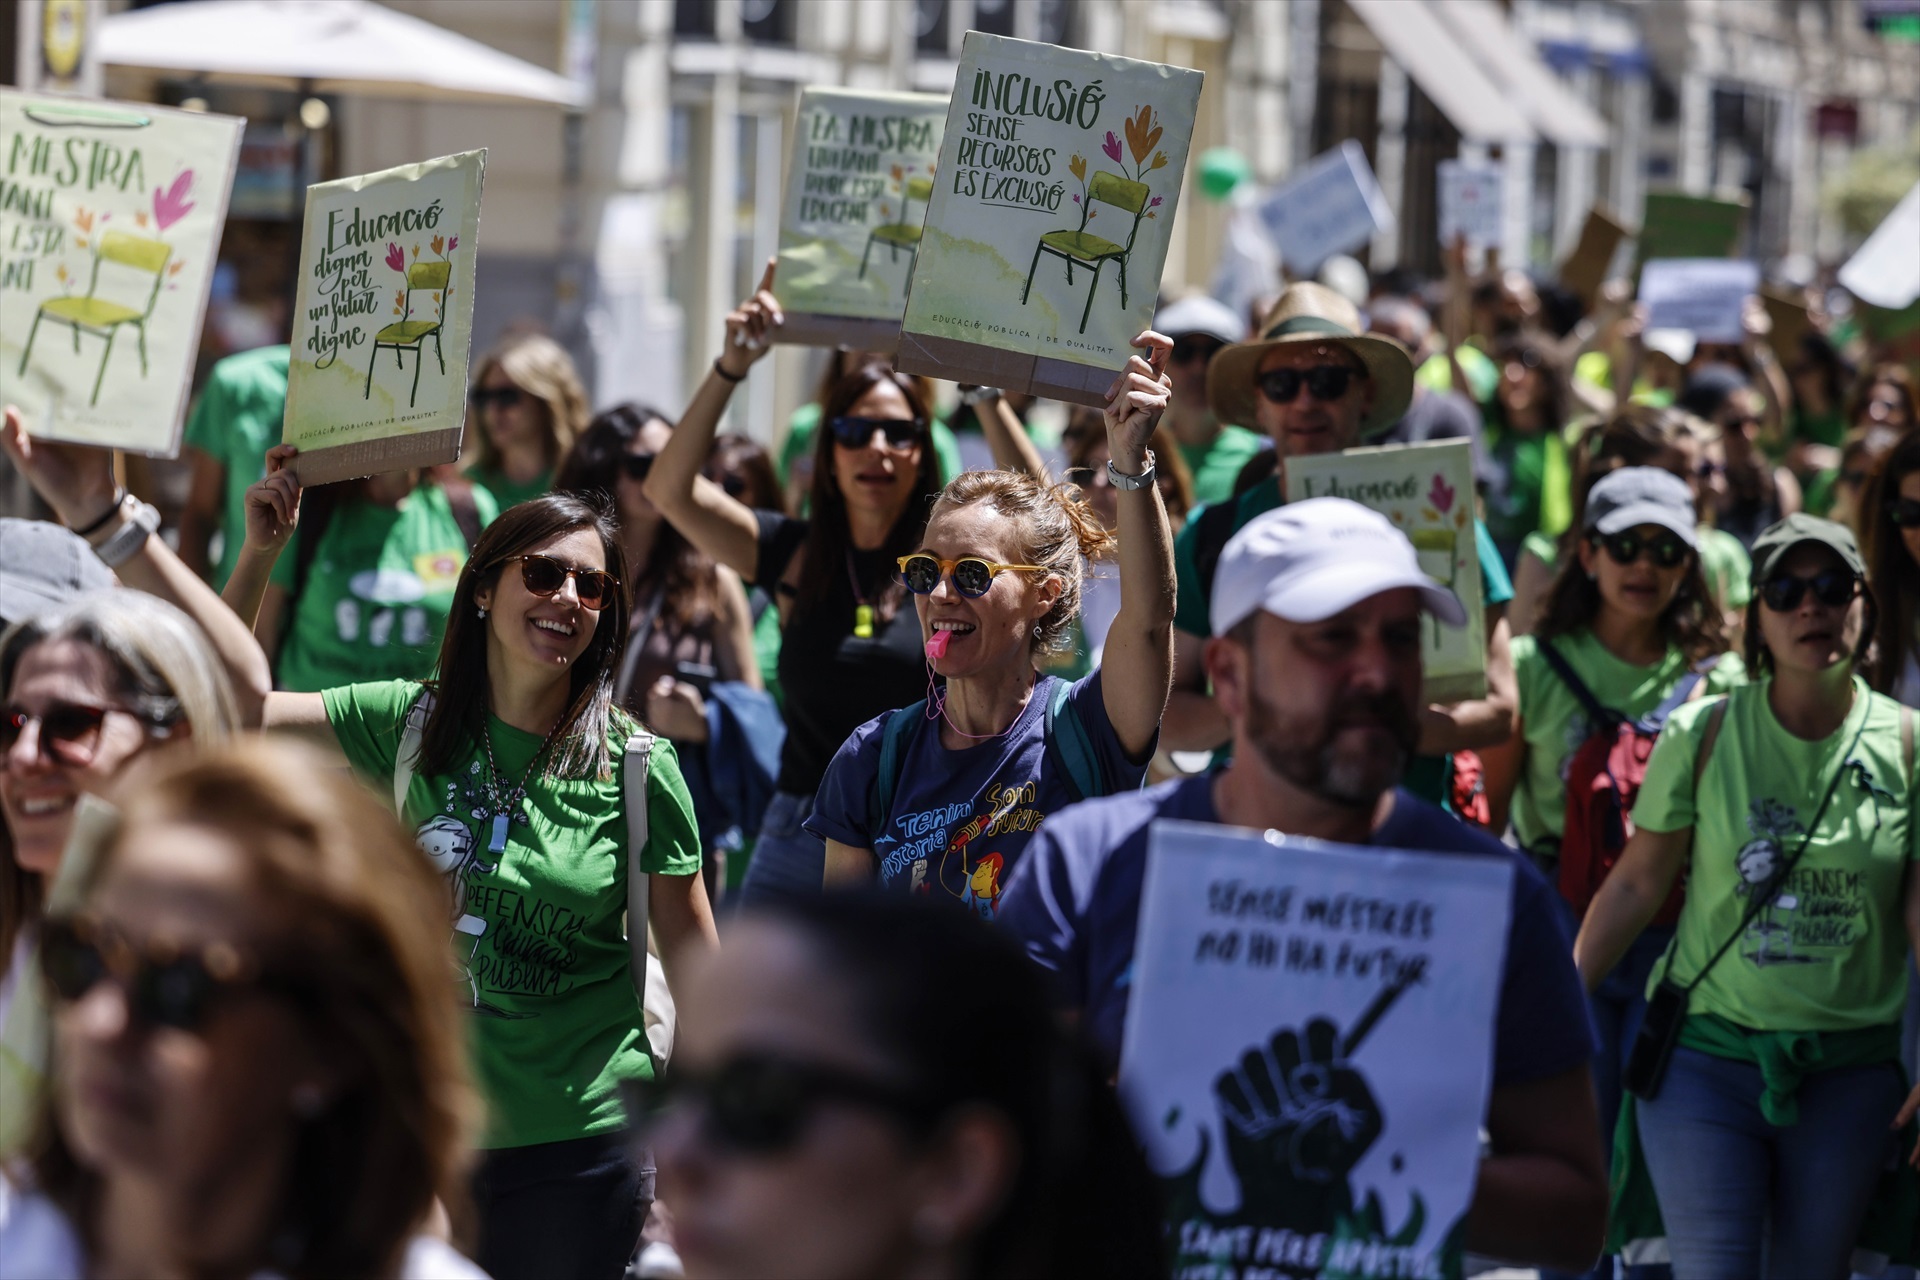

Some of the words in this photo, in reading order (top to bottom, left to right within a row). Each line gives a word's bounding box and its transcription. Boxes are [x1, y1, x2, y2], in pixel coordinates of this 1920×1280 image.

[972, 68, 1106, 130] INCLUSIÓ
[966, 113, 1024, 141] SENSE
[10, 132, 145, 193] MESTRA
[957, 137, 1056, 176] RECURSOS
[954, 169, 980, 197] ÉS
[981, 172, 1065, 210] EXCLUSIÓ
[327, 199, 444, 255] Educació
[314, 247, 373, 296] digna
[341, 269, 373, 302] per
[309, 304, 329, 322] un
[330, 285, 382, 335] futur
[308, 325, 366, 369] digne
[932, 314, 982, 330] EDUCACIÓ
[987, 324, 1030, 338] PÚBLICA
[1046, 336, 1058, 344] DE
[1066, 340, 1114, 355] QUALITAT
[299, 425, 336, 440] EDUCACIÓ
[401, 411, 438, 422] QUALITAT
